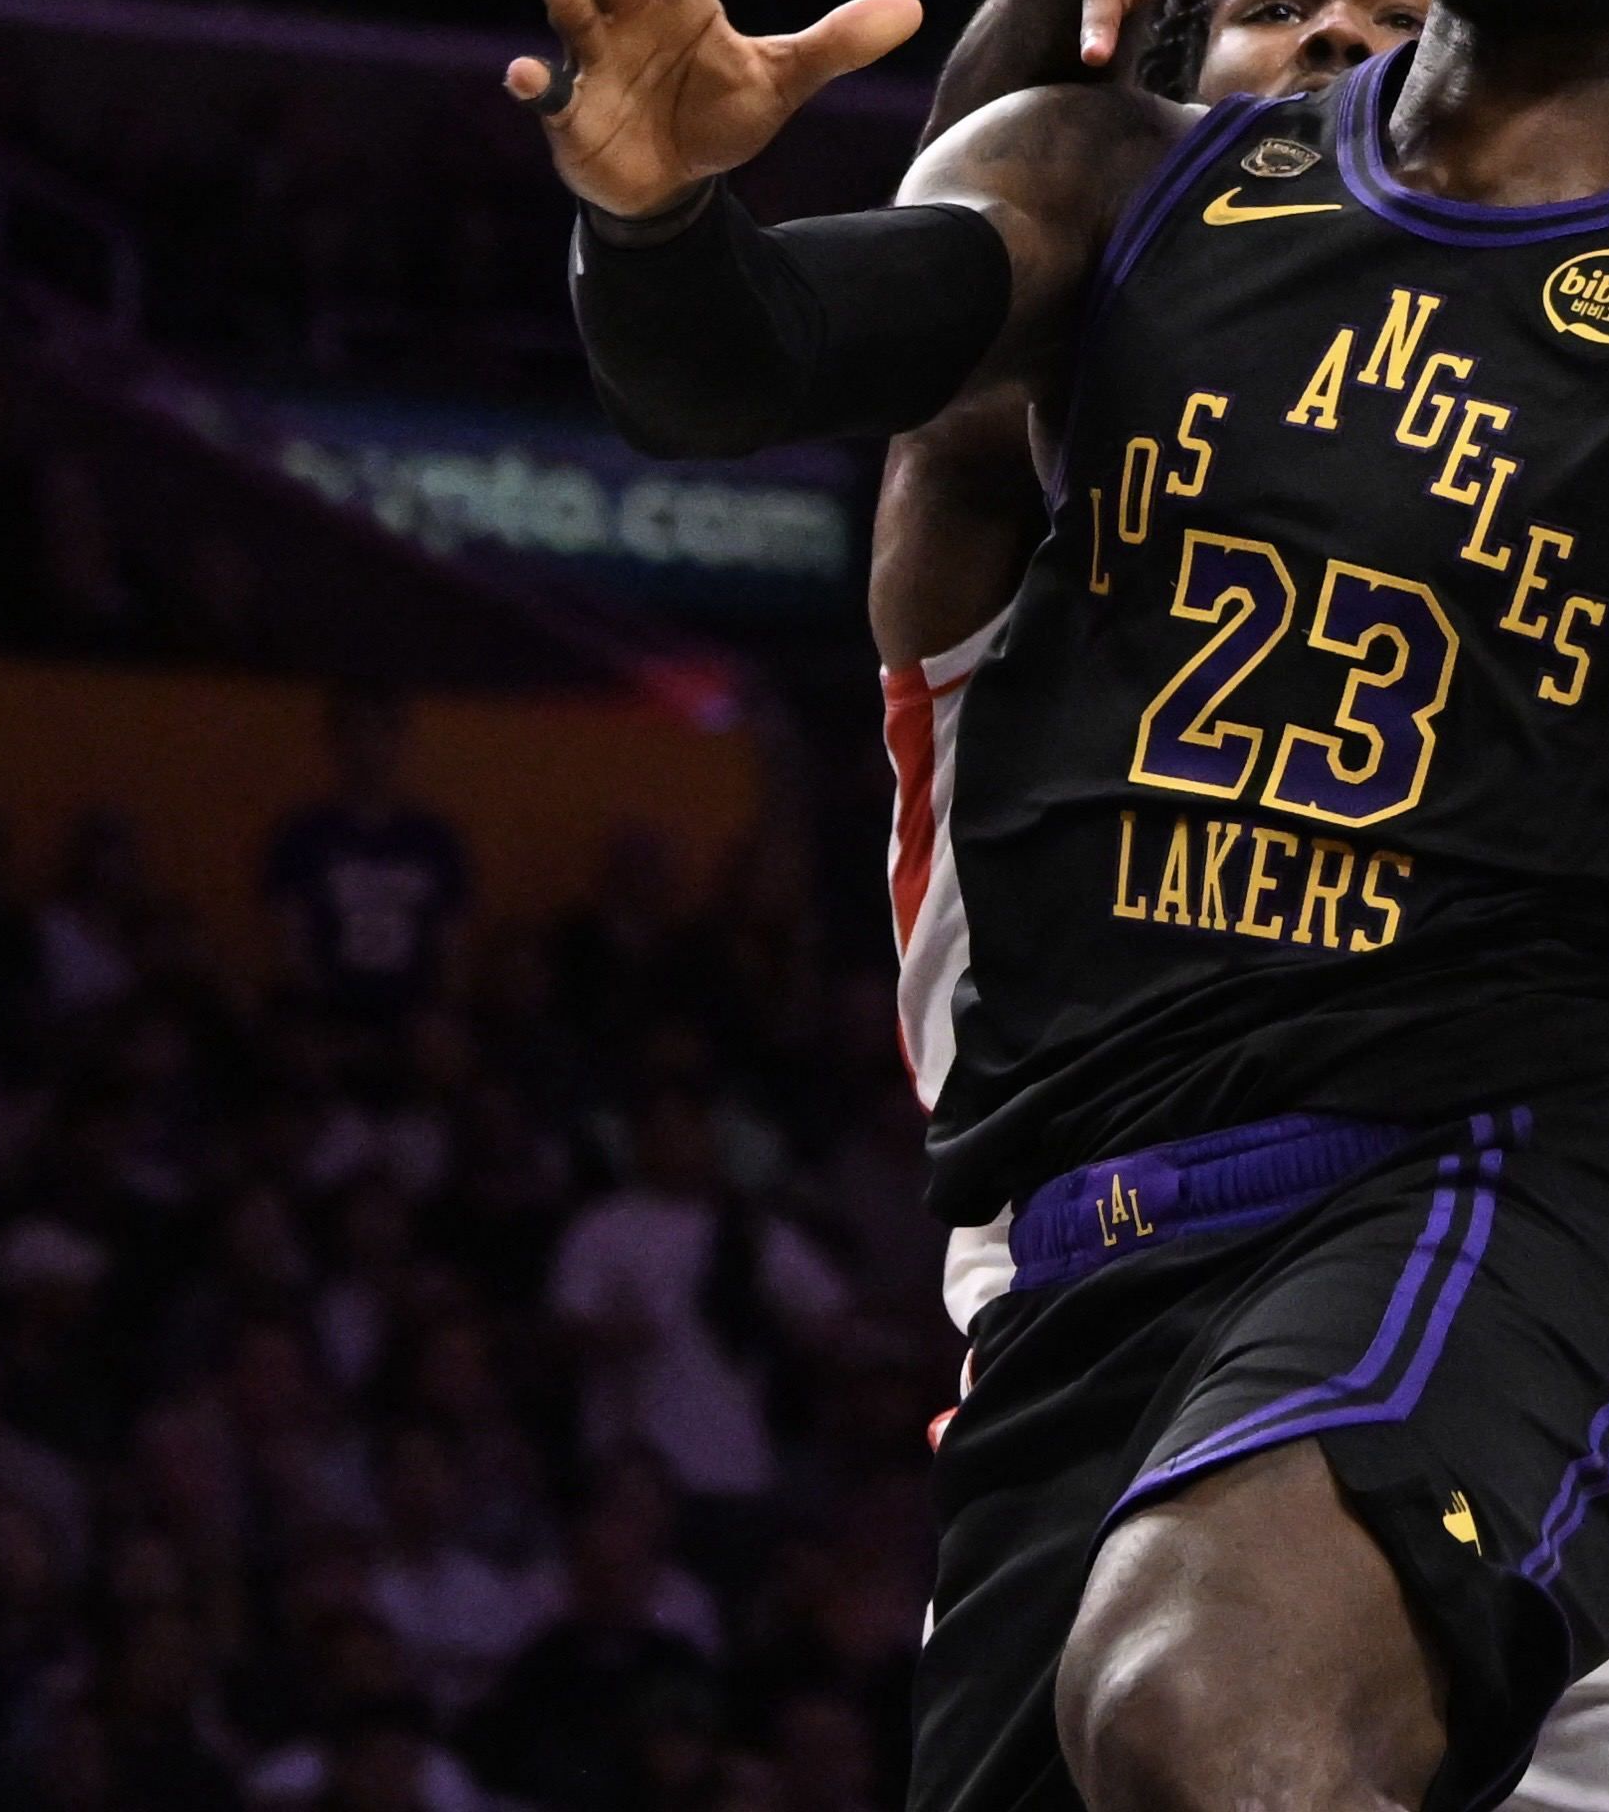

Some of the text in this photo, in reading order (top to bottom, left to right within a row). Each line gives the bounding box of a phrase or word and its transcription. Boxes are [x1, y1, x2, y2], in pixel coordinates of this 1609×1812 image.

[1089, 288, 1605, 707] LOS ANGELES
[1128, 527, 1461, 829] 23
[1112, 809, 1413, 953] LAKERS
[1096, 1174, 1154, 1247] LAL
